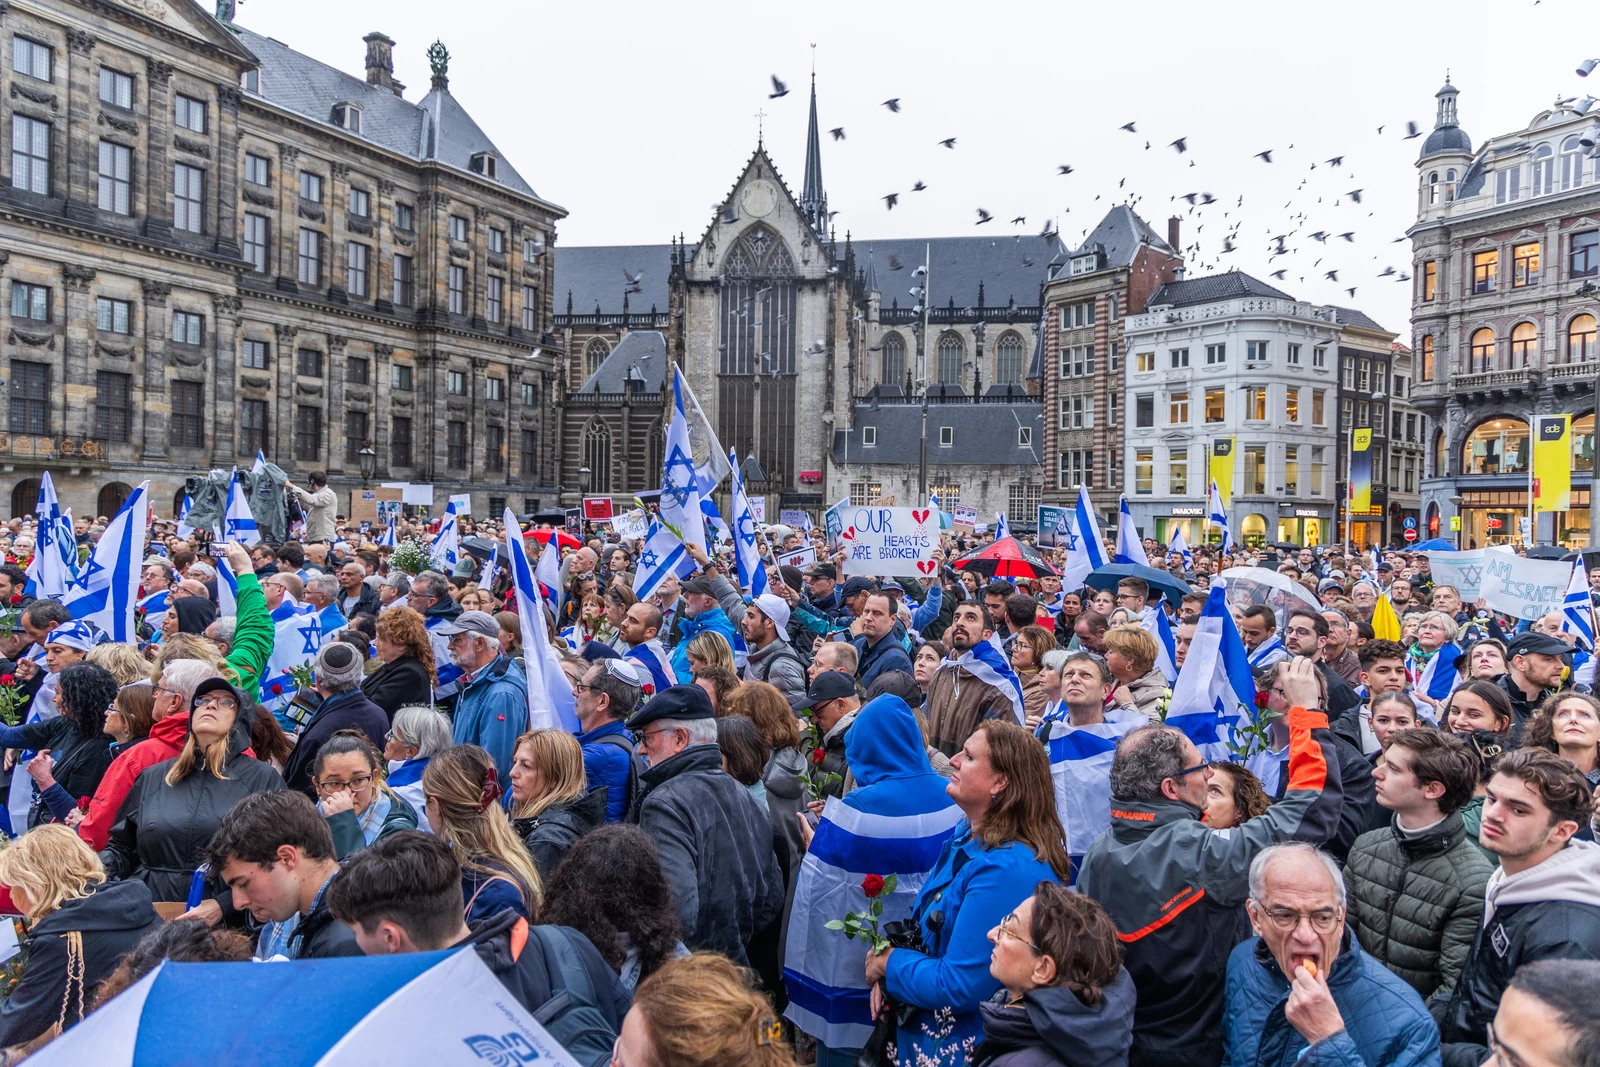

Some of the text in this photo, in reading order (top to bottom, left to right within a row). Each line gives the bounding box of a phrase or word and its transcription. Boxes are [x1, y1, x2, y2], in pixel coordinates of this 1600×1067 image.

[1545, 424, 1560, 434] ade
[854, 509, 892, 533] OUR
[884, 535, 930, 547] HEARTS
[852, 546, 920, 560] ARE BROKEN
[1486, 559, 1512, 580] AM
[1500, 579, 1562, 602] ISRAEL
[1522, 604, 1558, 619] CHA
[496, 1001, 555, 1060] Amsterdam
